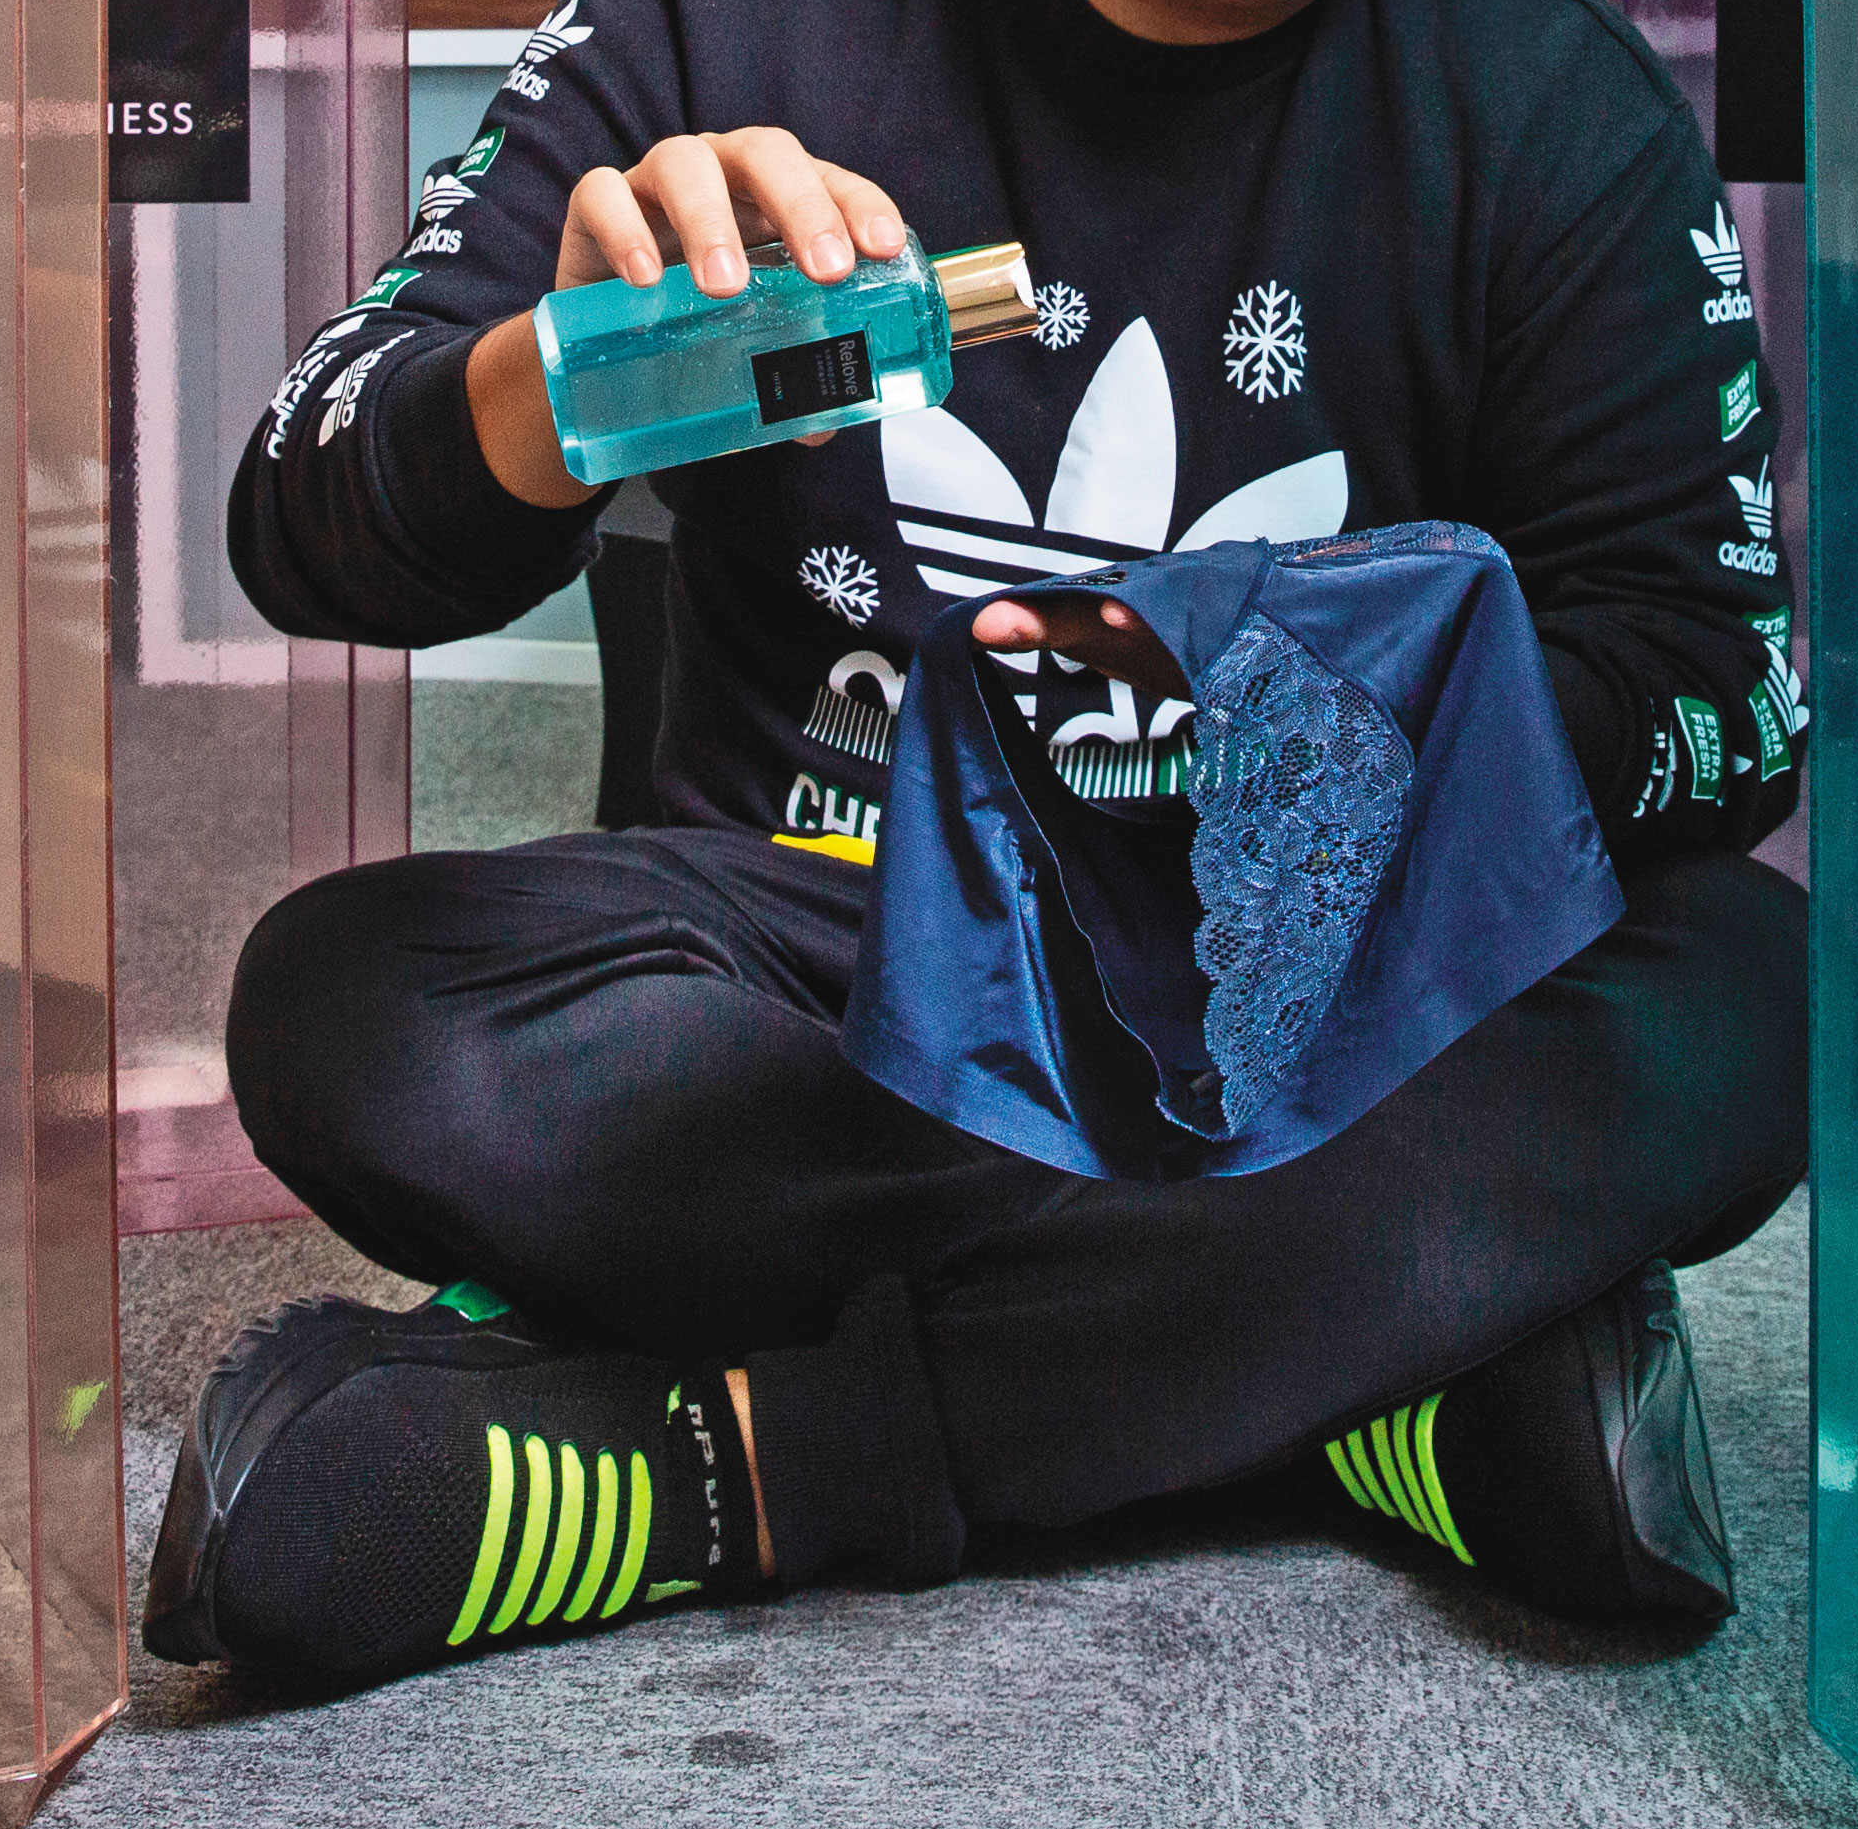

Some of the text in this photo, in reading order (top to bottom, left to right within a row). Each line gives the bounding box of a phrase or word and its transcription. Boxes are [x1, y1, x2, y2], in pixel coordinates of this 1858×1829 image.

[1702, 288, 1753, 324] adida
[1718, 541, 1778, 577] adidas
[1690, 712, 1711, 779] FRESH
[1704, 713, 1721, 782] EXTRA
